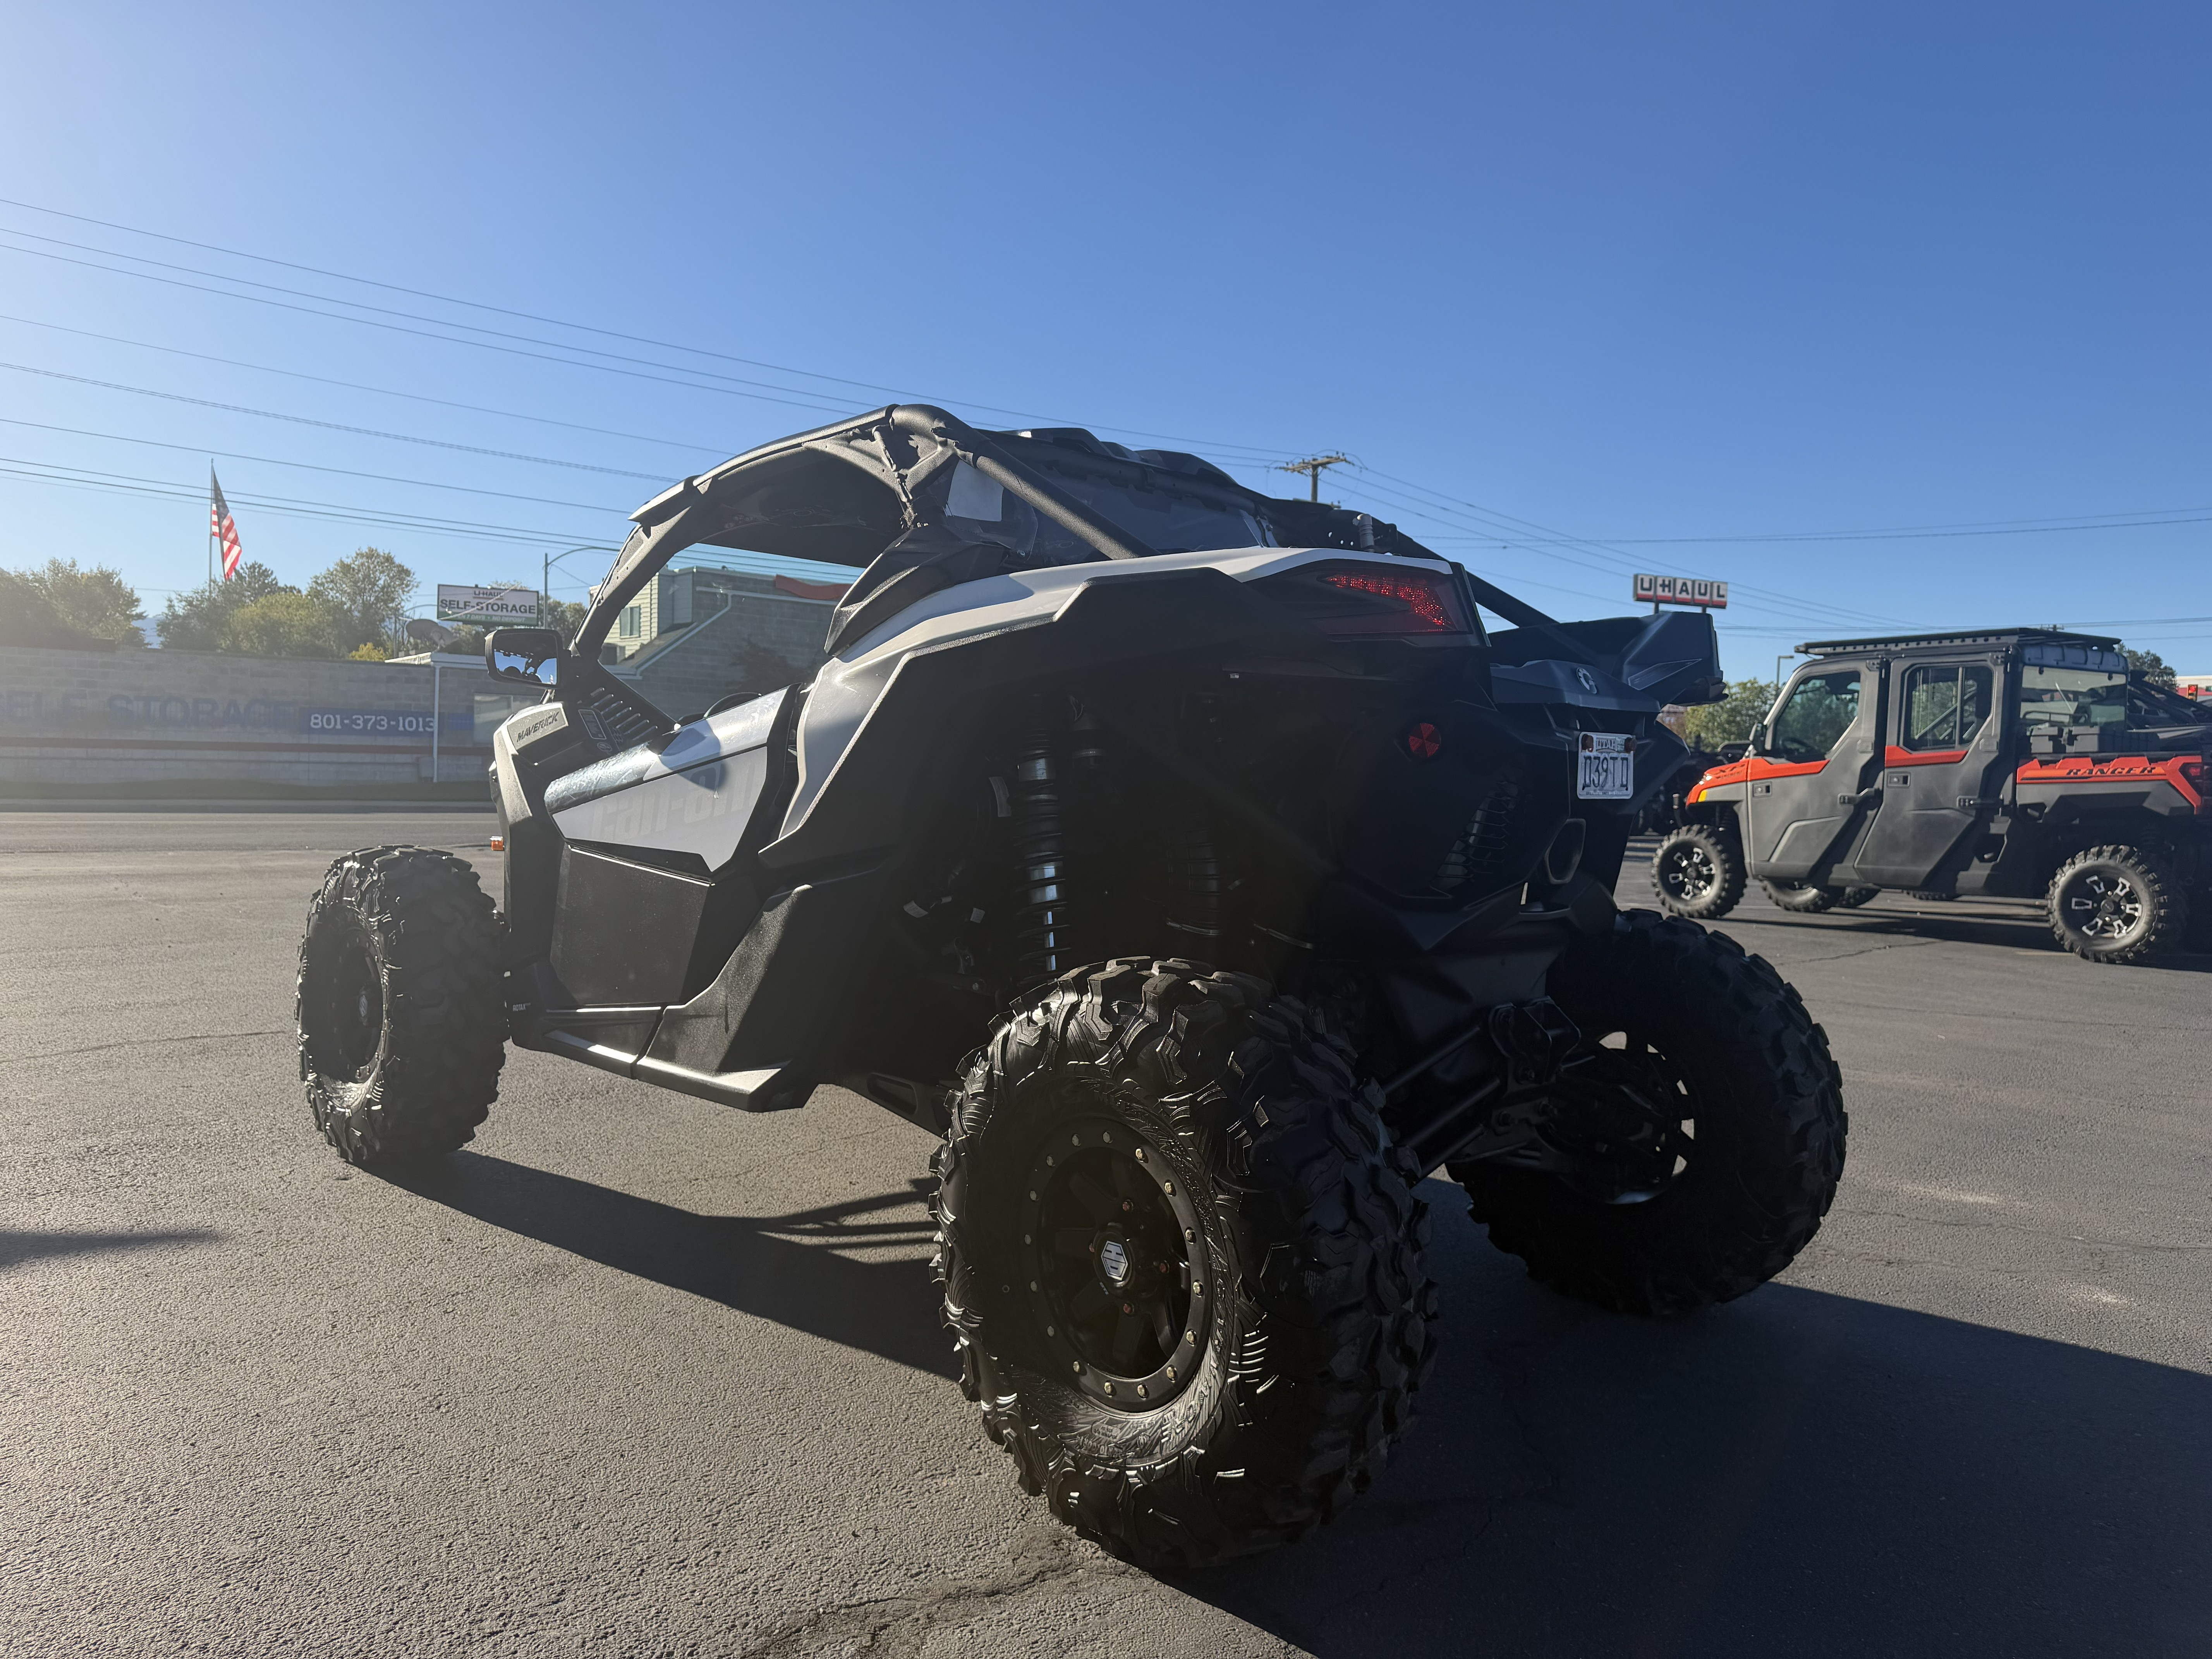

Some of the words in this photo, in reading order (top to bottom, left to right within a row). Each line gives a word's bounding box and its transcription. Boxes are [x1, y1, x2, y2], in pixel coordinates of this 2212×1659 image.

[440, 599, 536, 614] SELF-STORAGE
[0, 691, 87, 723] ELF
[107, 694, 297, 728] STORAGE
[310, 713, 434, 732] 801-373-1013
[517, 711, 560, 742] MAVERICK
[1596, 739, 1616, 749] UTAH
[2066, 766, 2156, 775] RANGER
